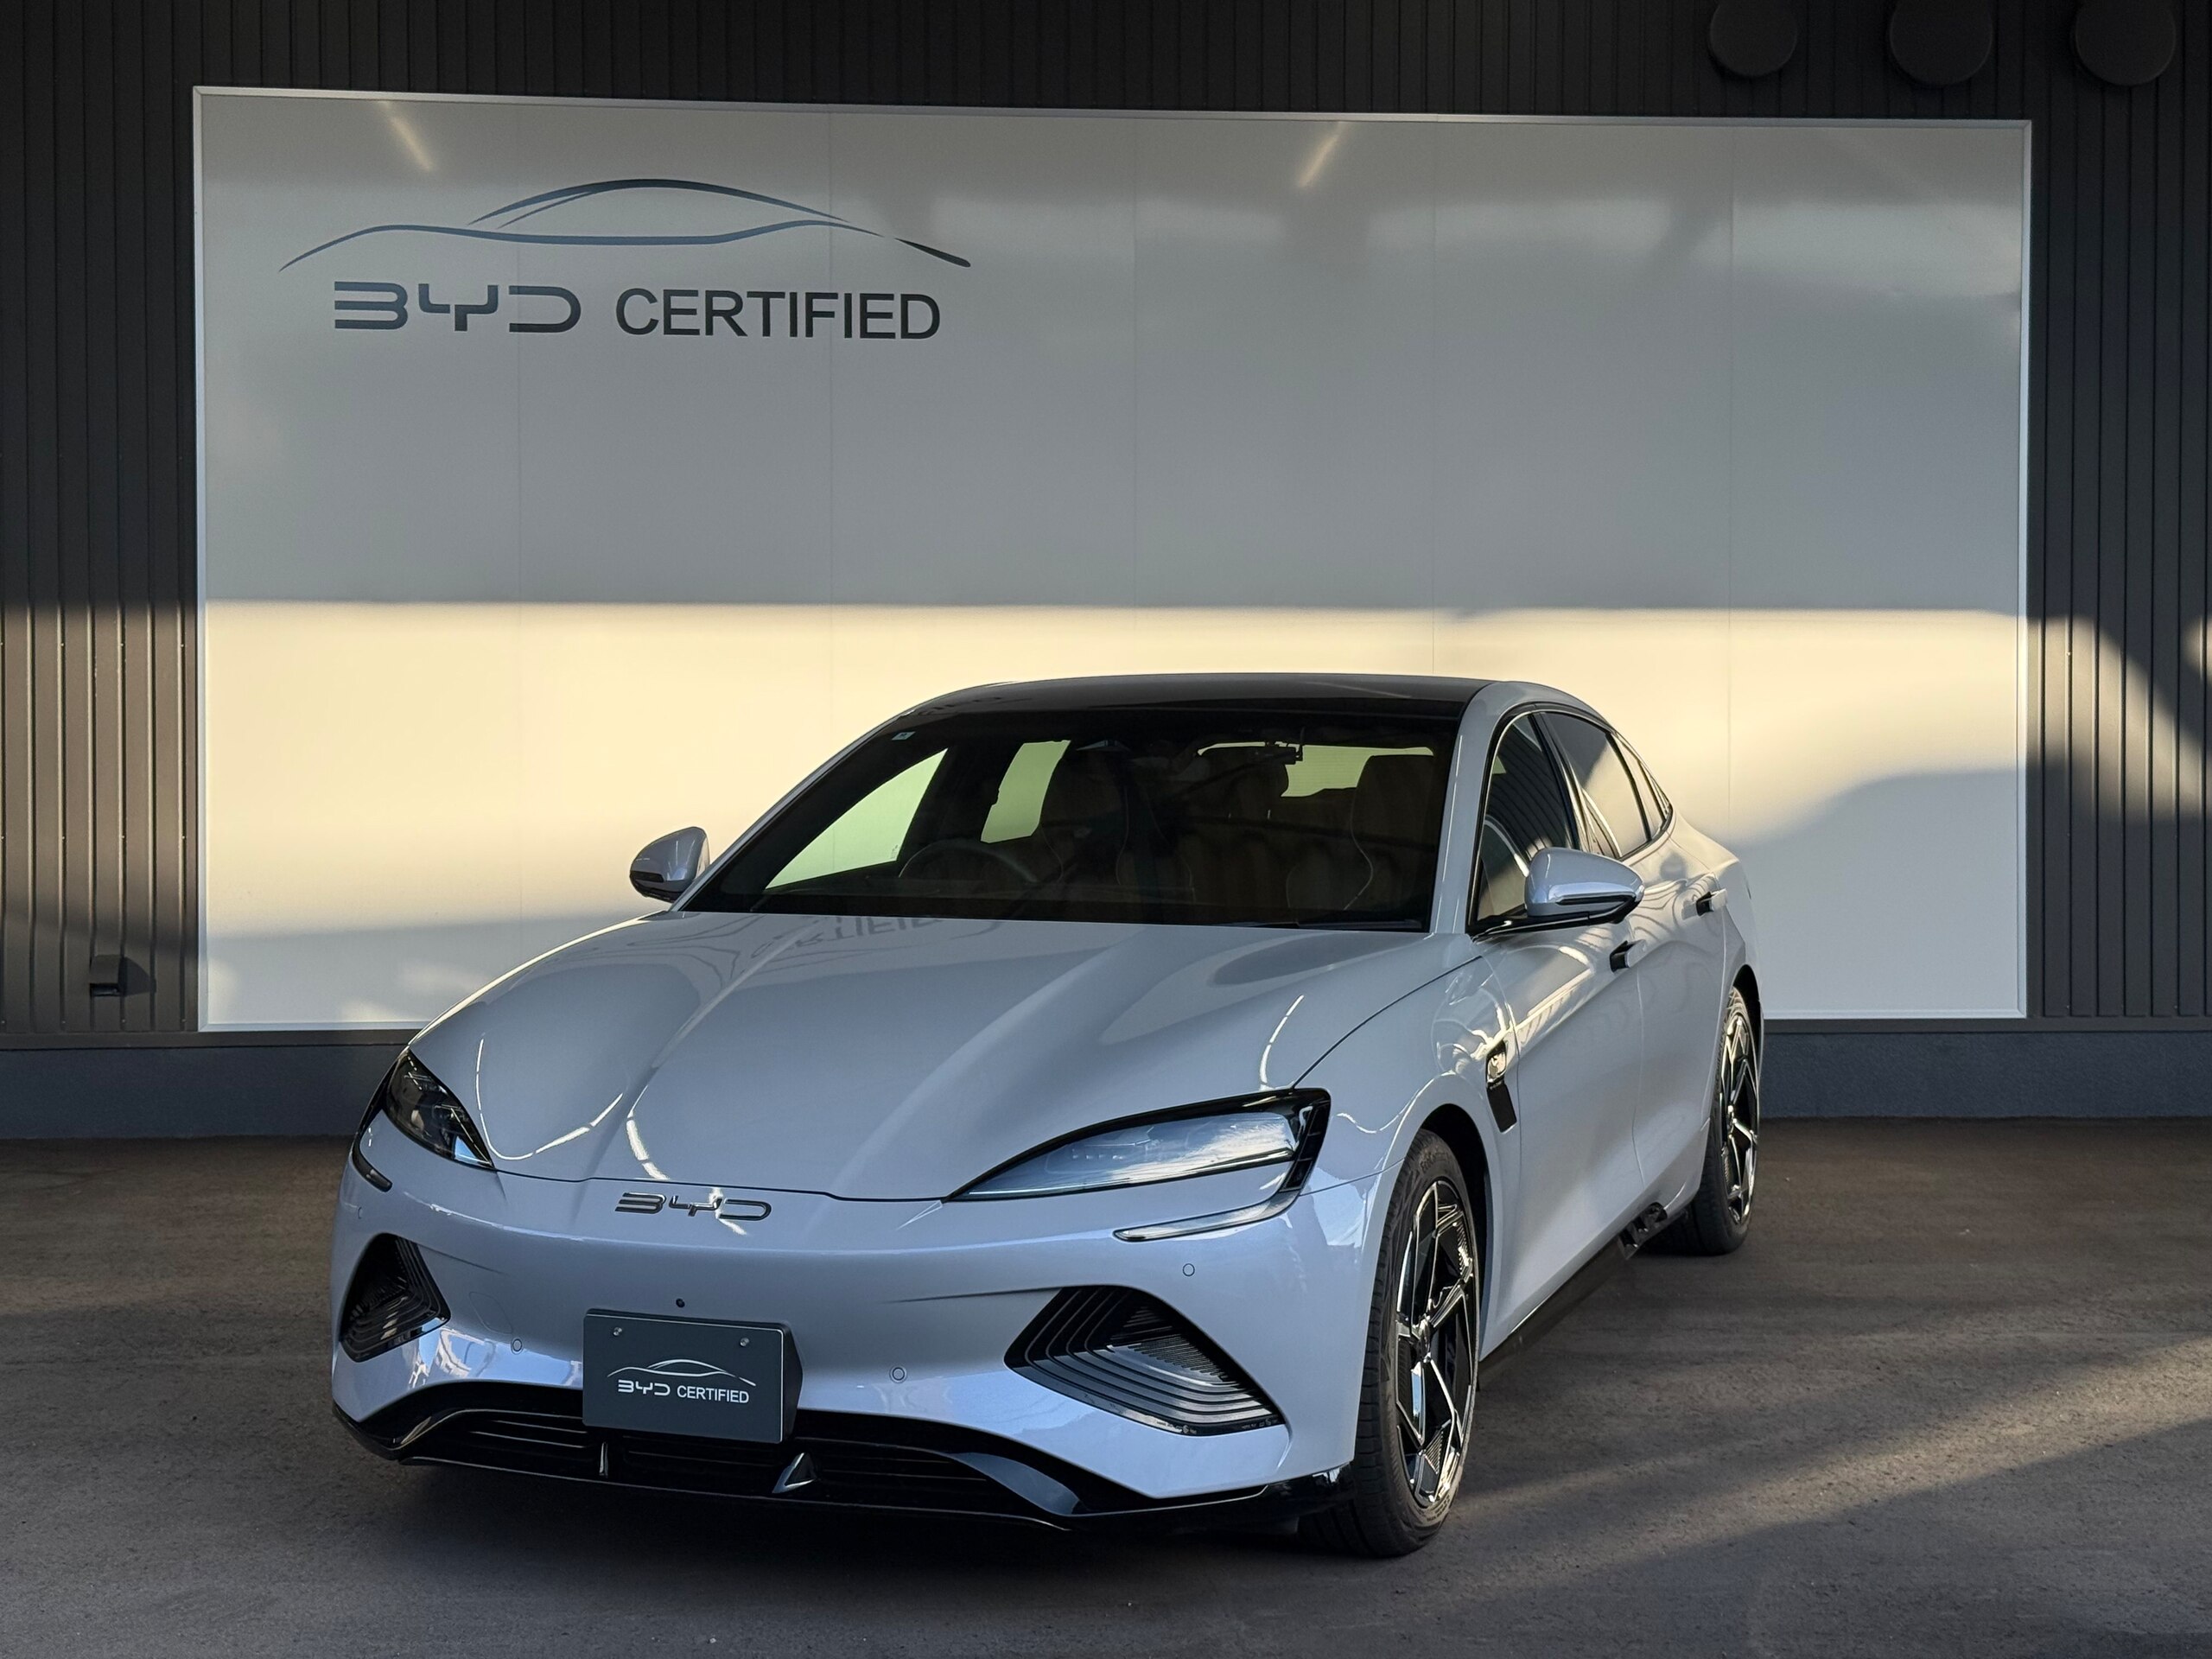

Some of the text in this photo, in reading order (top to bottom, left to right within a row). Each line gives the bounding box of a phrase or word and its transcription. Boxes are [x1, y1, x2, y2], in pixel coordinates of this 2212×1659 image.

[334, 281, 941, 340] BYD CERTIFIED
[614, 1192, 772, 1222] BYD
[618, 1379, 749, 1404] BYD CERTIFIED
